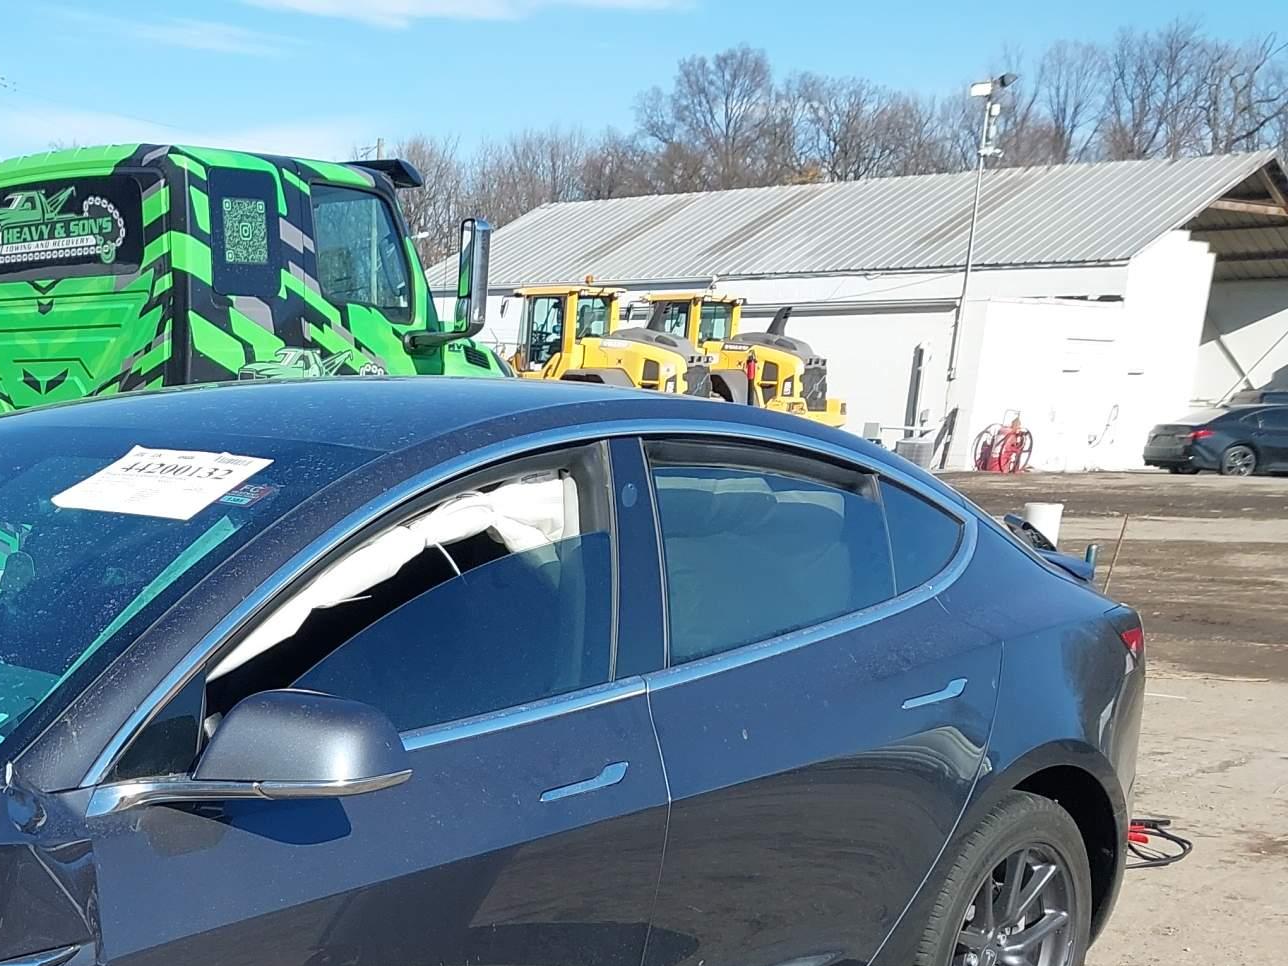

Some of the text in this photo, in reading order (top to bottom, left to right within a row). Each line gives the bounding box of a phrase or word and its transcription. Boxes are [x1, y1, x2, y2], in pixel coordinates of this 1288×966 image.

[3, 217, 112, 243] HEAVY & SON'S
[5, 237, 90, 252] TOWING AND RECOVERY
[121, 460, 233, 480] 44200132
